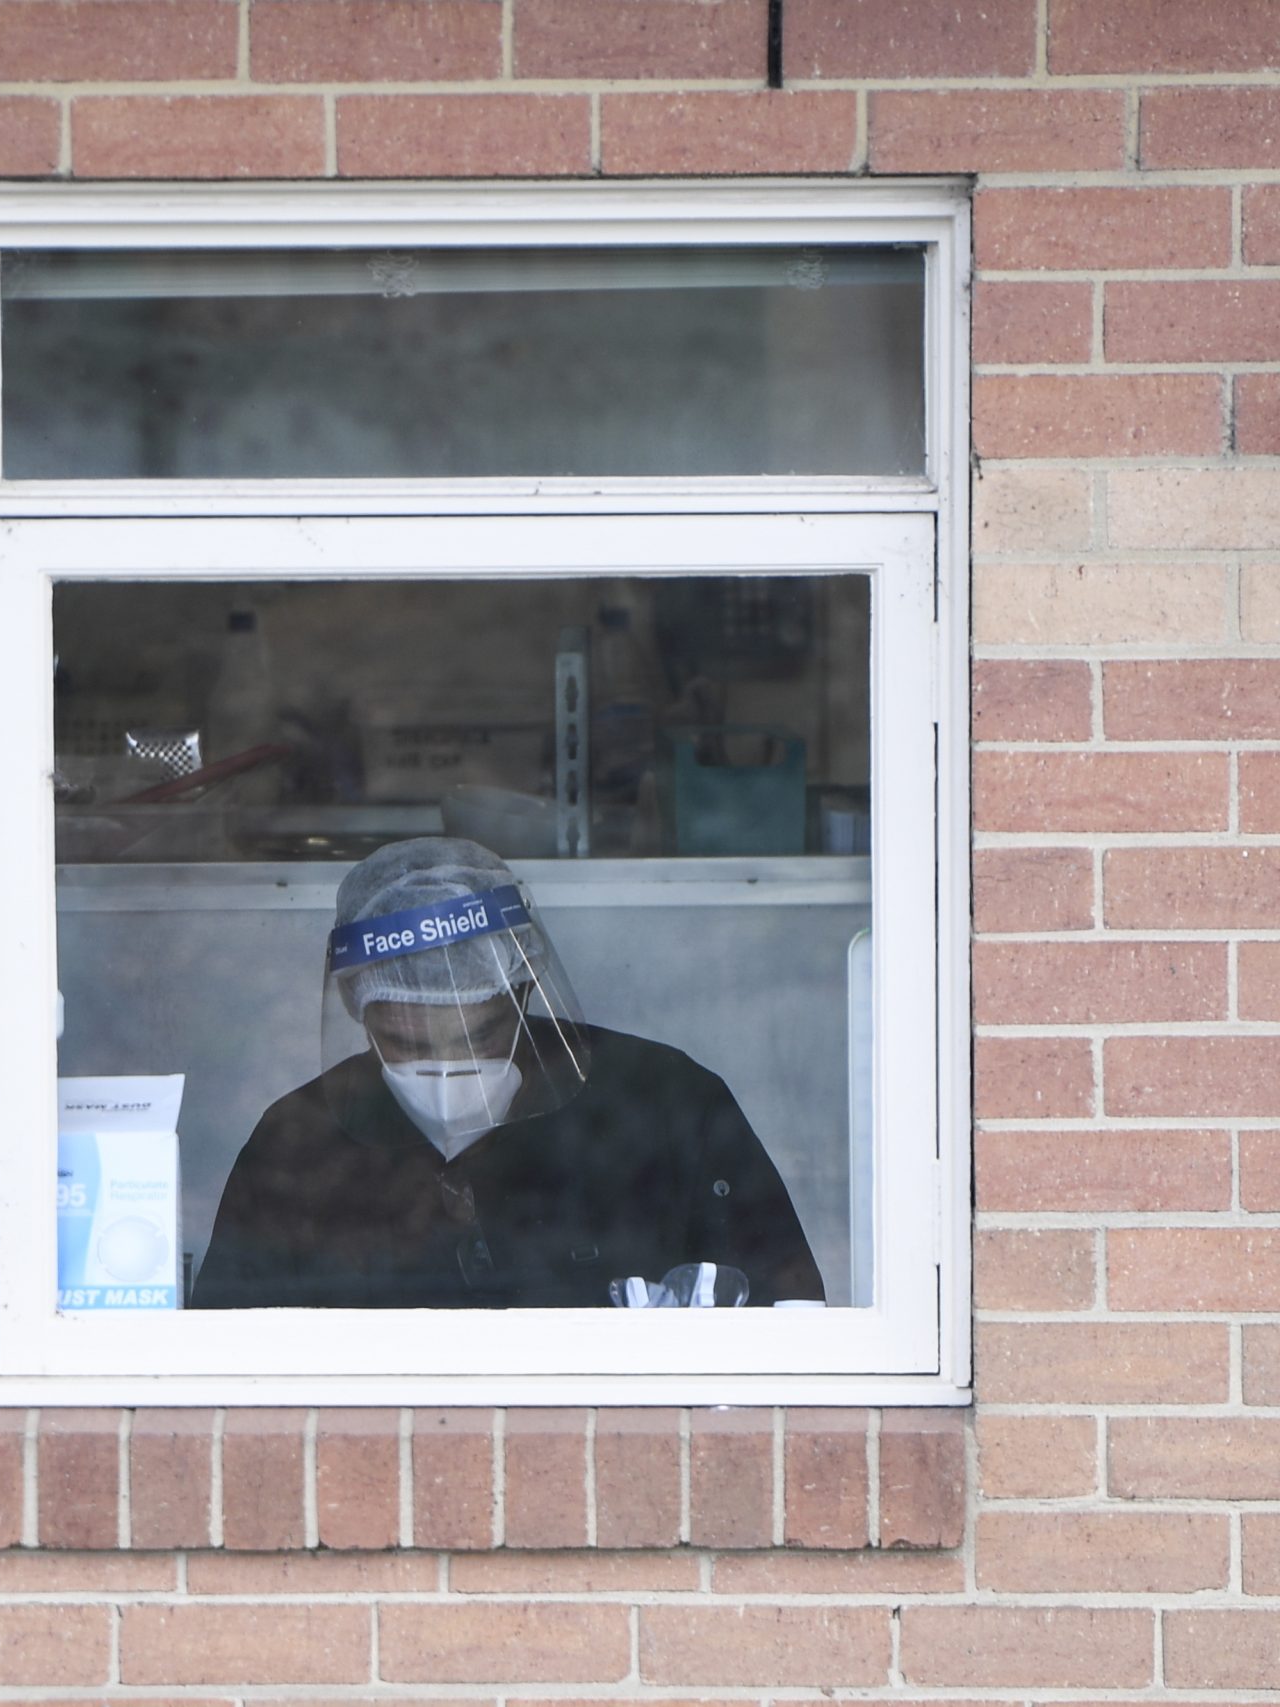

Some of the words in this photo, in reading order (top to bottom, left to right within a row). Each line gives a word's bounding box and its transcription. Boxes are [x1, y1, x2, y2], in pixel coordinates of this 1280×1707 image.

[362, 929, 415, 955] Face
[420, 906, 489, 942] Shield
[57, 1183, 87, 1208] 95
[57, 1288, 101, 1306] UST
[104, 1288, 169, 1306] MASK
